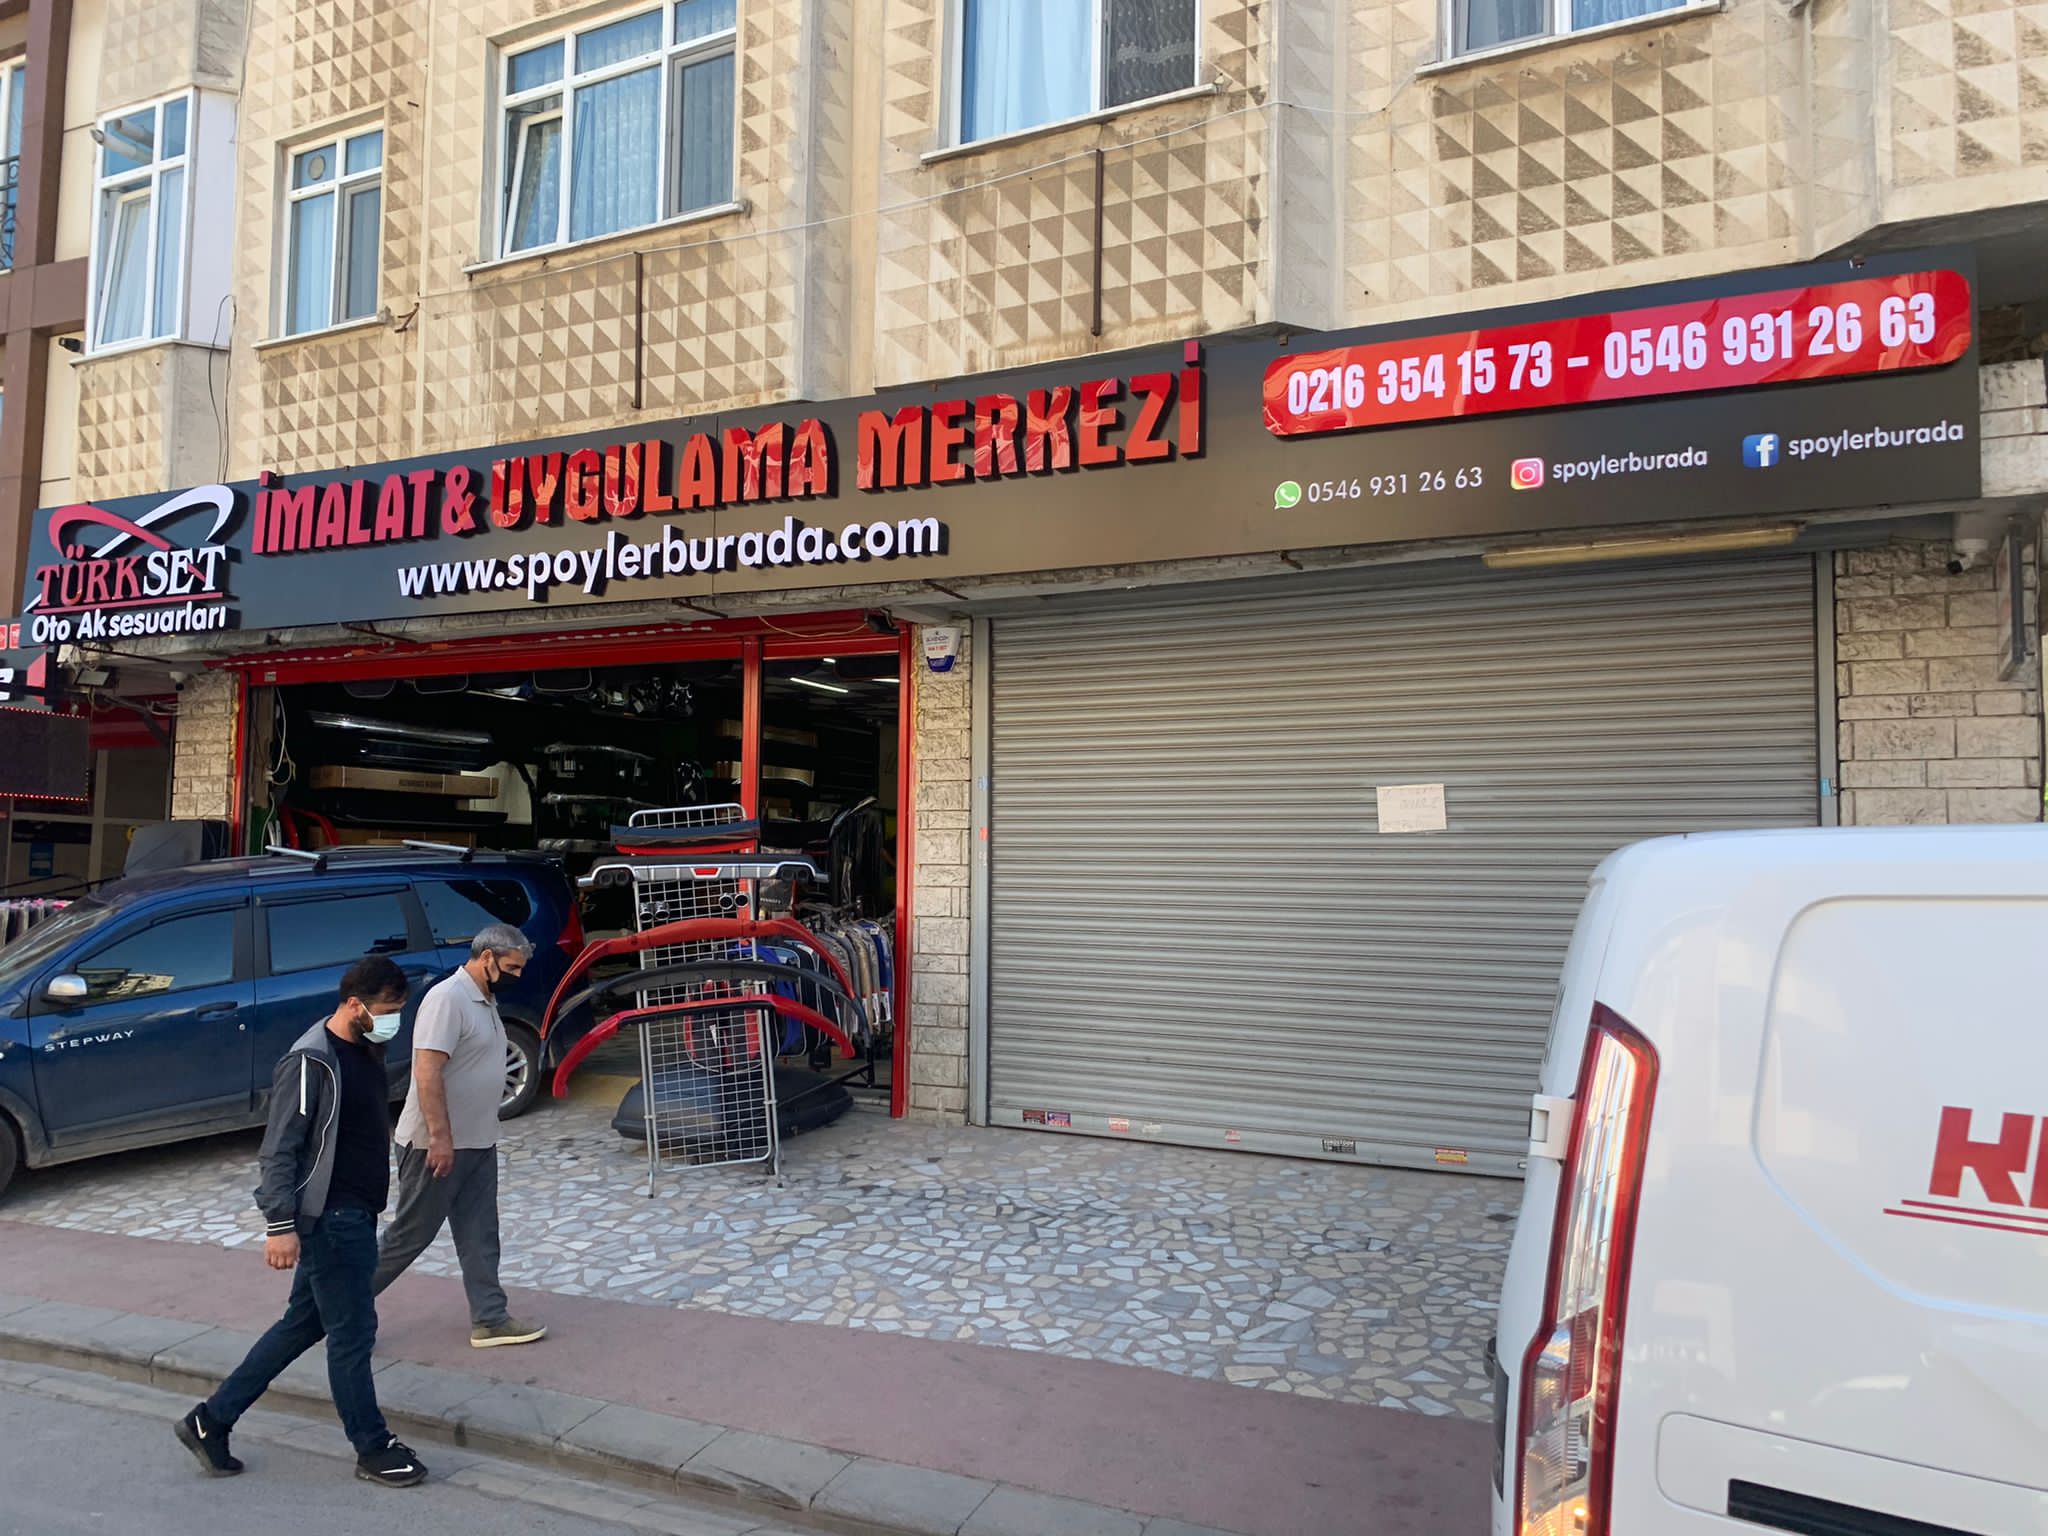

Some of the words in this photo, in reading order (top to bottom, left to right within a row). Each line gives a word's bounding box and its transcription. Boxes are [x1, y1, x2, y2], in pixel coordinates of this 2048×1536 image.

[1287, 363, 1366, 416] 0216
[1376, 353, 1446, 405] 354
[1457, 347, 1497, 395] 15
[1508, 340, 1553, 391] 73
[1603, 321, 1707, 380] 0546
[1722, 310, 1793, 366] 931
[1807, 302, 1862, 356] 26
[1879, 292, 1936, 348] 63
[251, 470, 436, 554] İMALAT
[443, 465, 478, 535] &
[491, 417, 828, 529] UYGULAMA
[856, 340, 1202, 490] MERKEZİ
[1787, 419, 1965, 461] spoylerburada
[1307, 479, 1362, 503] 0546
[1369, 473, 1408, 497] 931
[1418, 470, 1446, 493] 26
[1454, 466, 1483, 489] 63
[1552, 446, 1708, 484] spoylerburada
[397, 514, 940, 601] www.spoylerburada.com
[31, 614, 72, 643] Oto
[44, 1029, 134, 1052] STEPWAY
